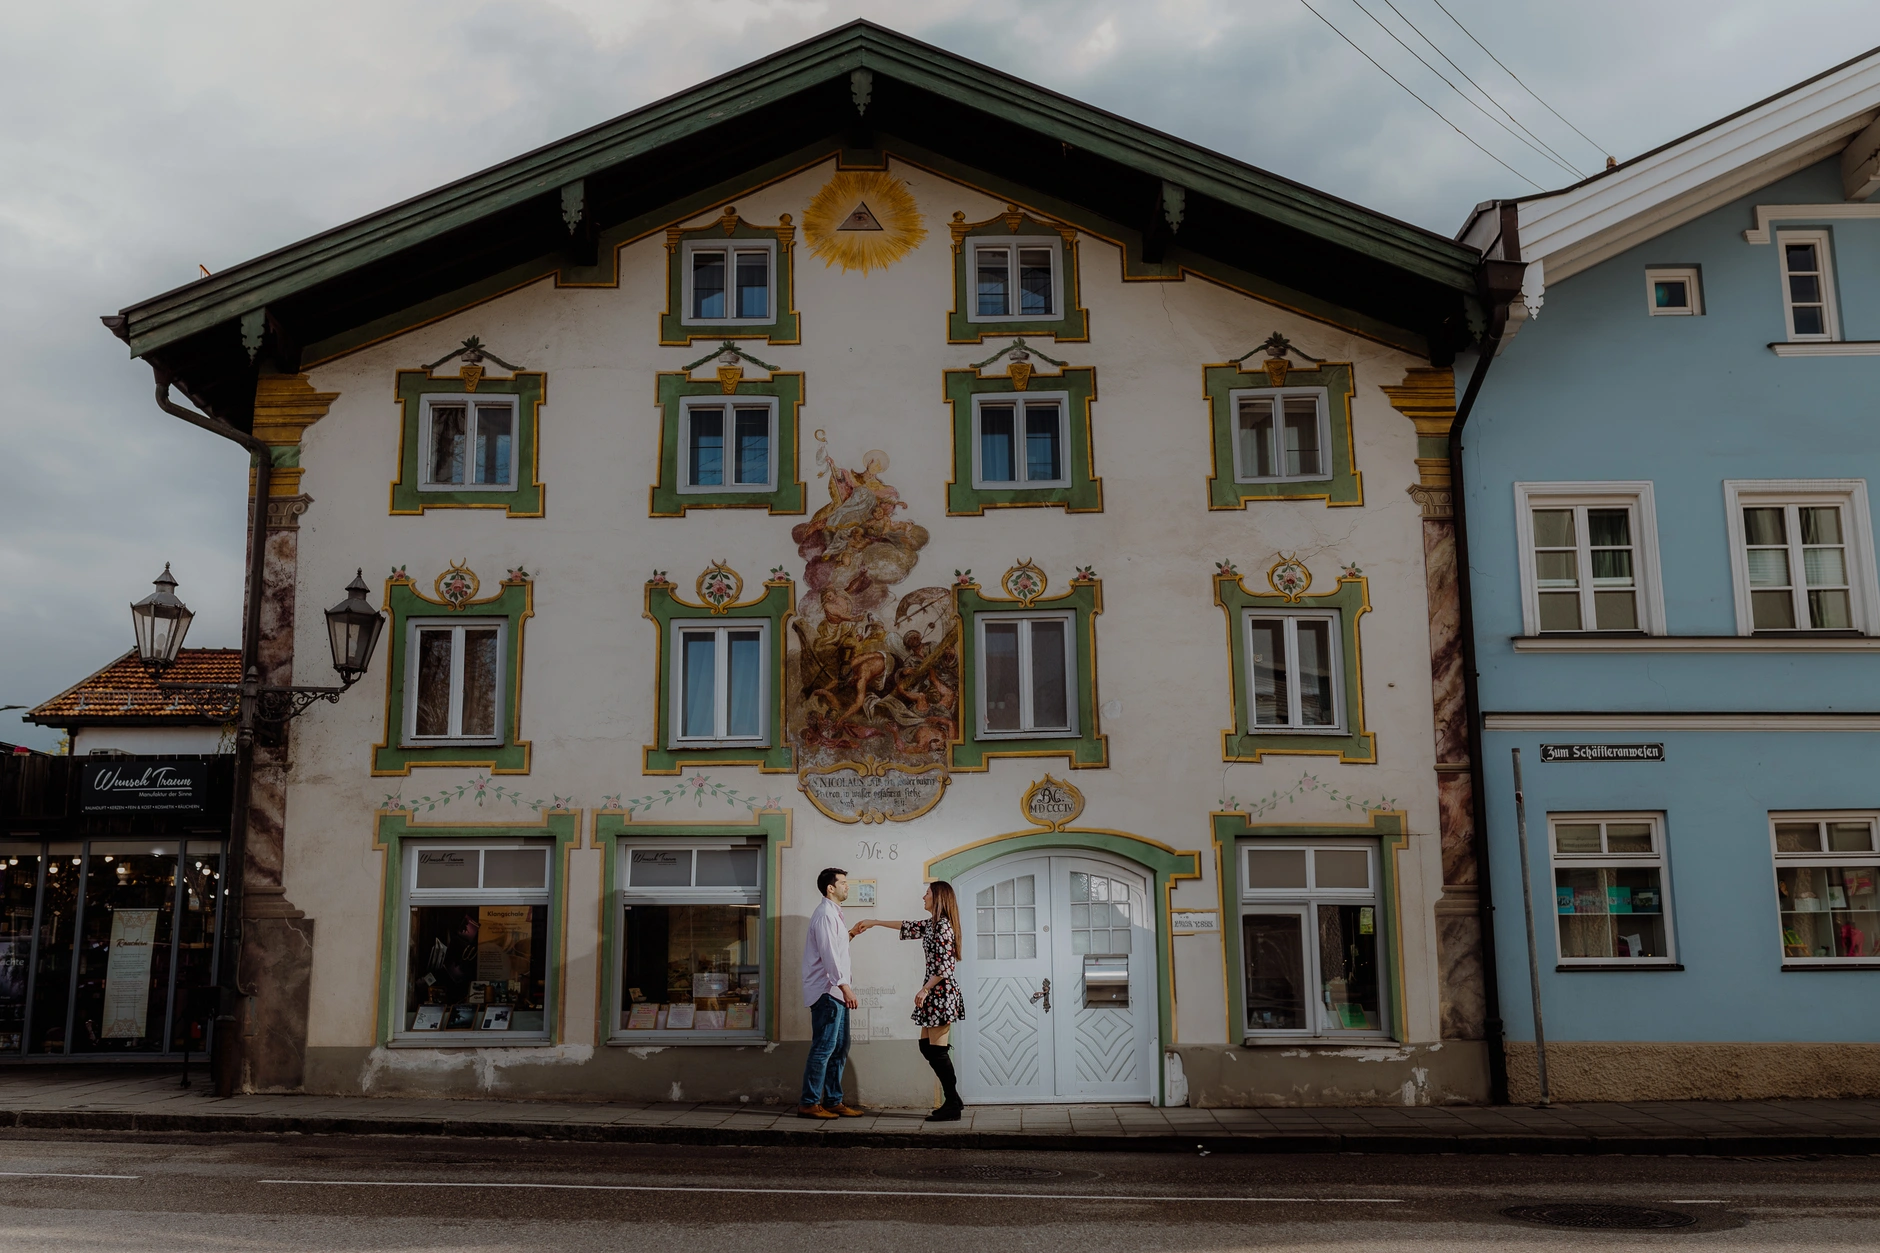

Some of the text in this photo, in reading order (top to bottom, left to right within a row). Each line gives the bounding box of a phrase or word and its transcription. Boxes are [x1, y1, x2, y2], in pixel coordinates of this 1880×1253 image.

[1546, 746, 1569, 760] Zum
[94, 766, 192, 791] Wunsch Traum
[855, 840, 899, 861] Nr. 8
[487, 910, 524, 918] Klangschale
